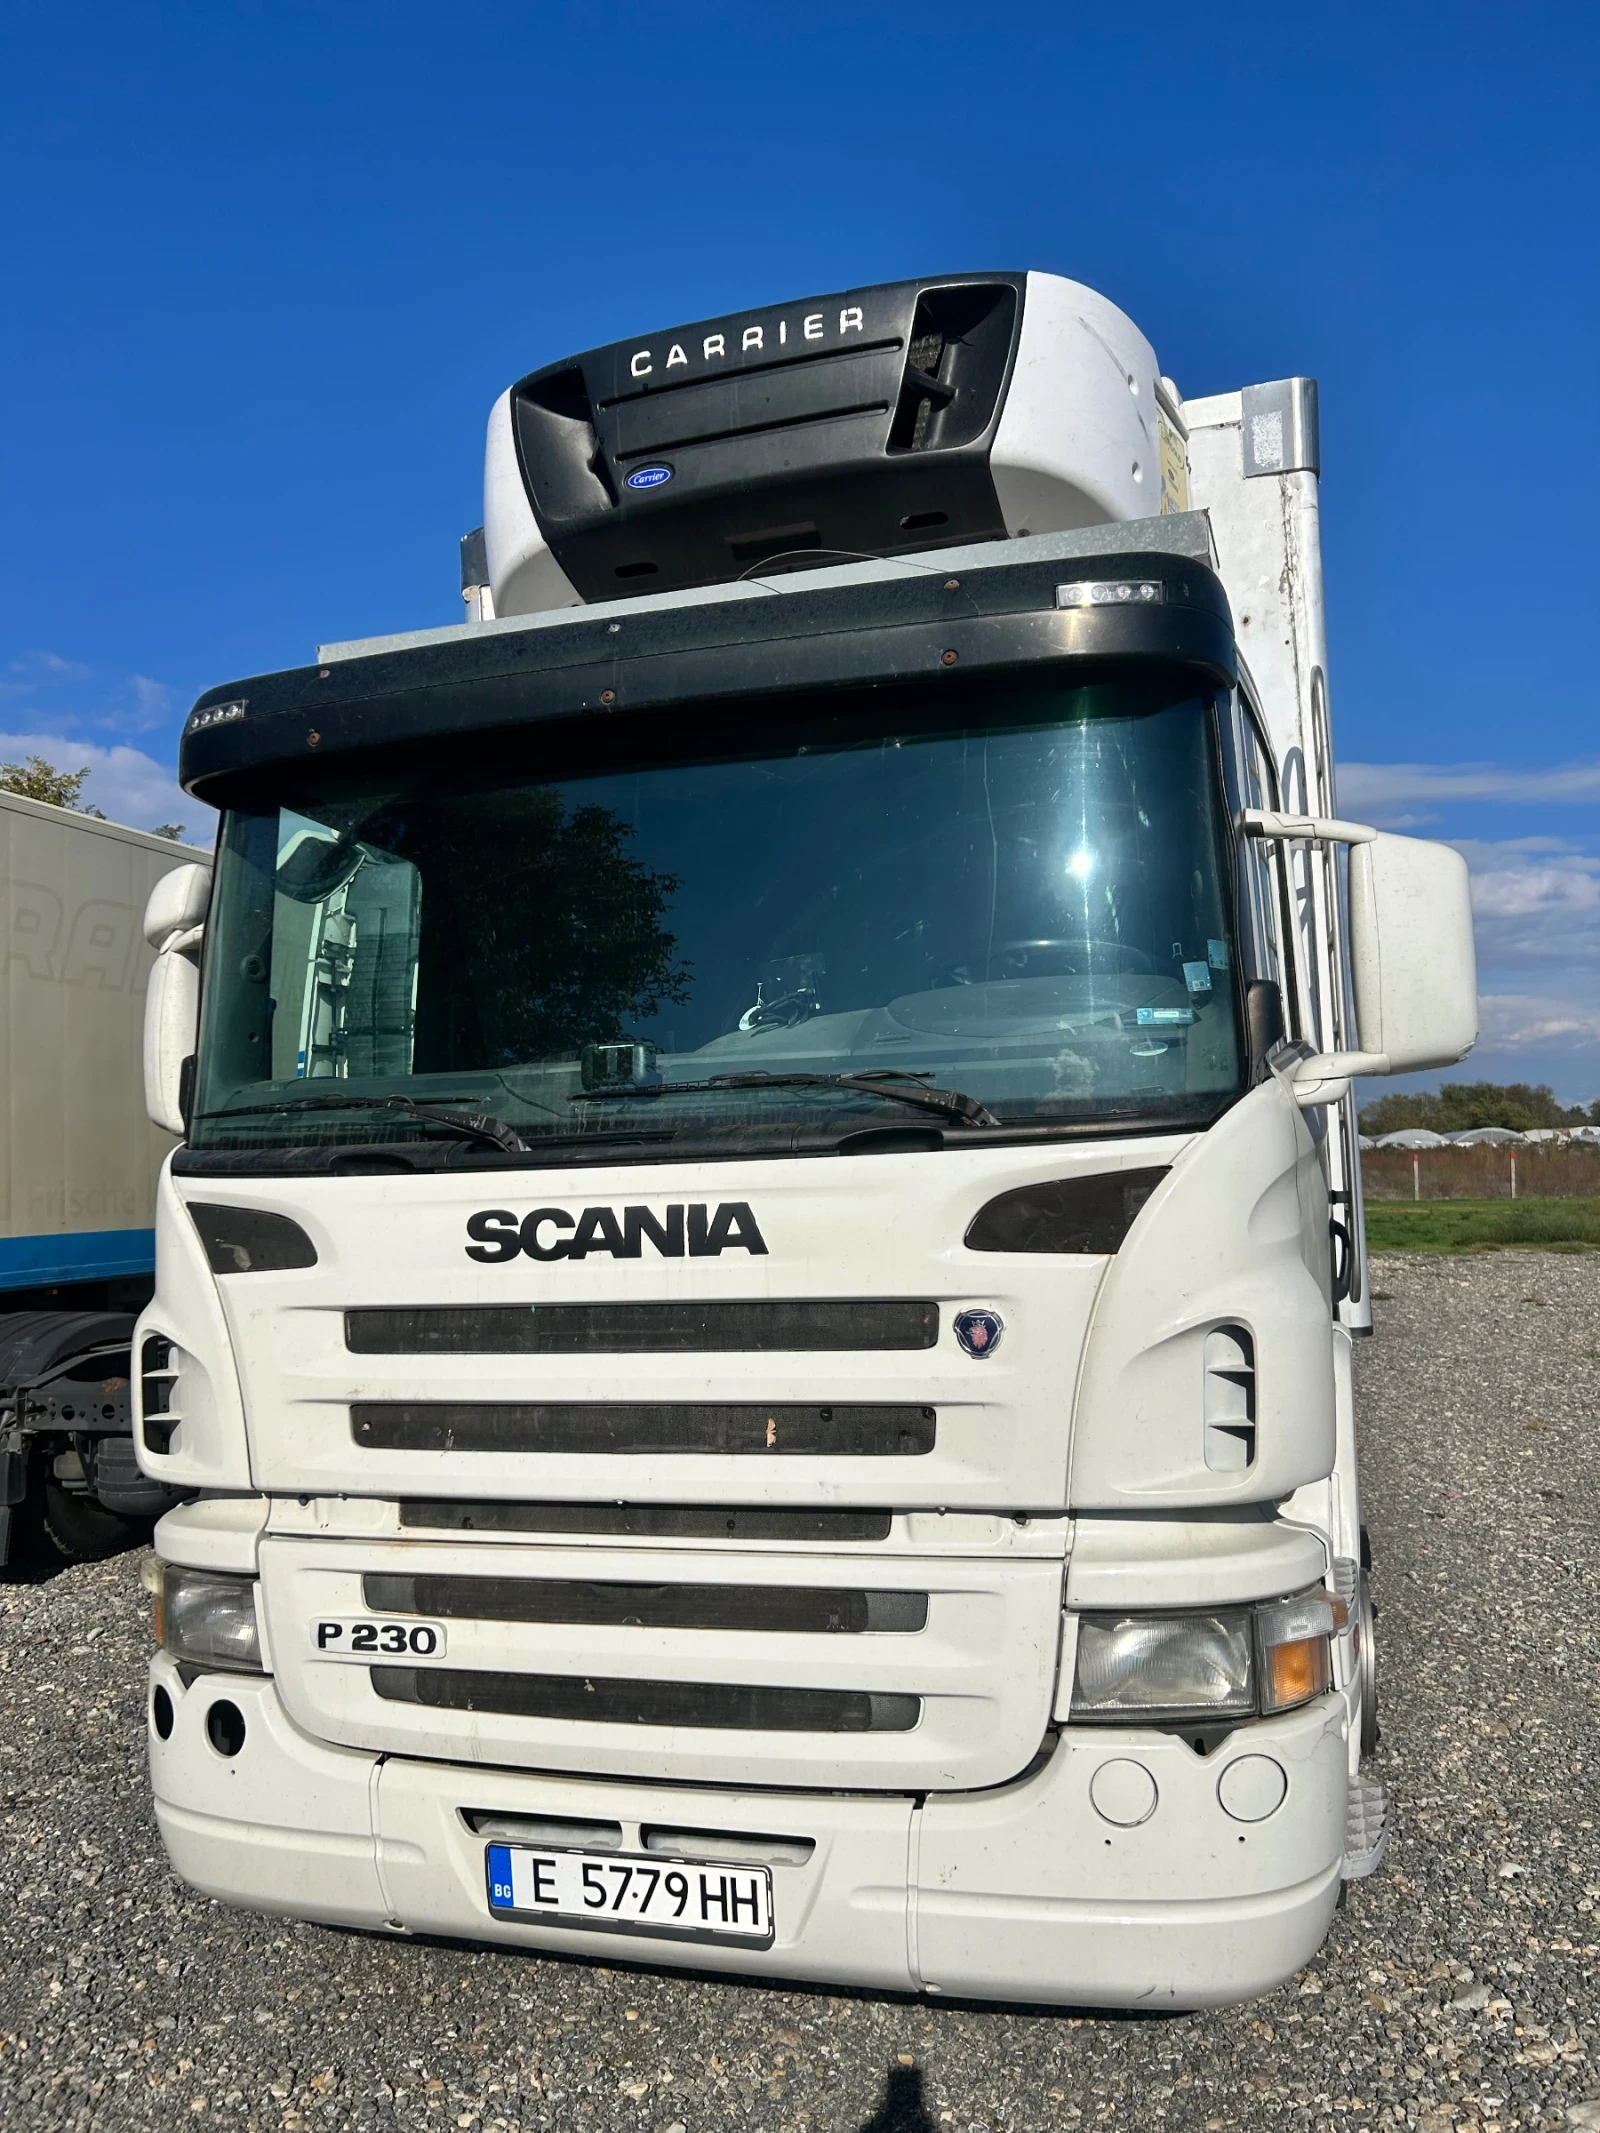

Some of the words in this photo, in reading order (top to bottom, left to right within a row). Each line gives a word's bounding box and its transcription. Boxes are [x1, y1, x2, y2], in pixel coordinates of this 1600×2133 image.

[630, 306, 864, 377] CARRIER
[633, 472, 665, 485] Carrier
[464, 1201, 770, 1264] SCANIA
[317, 1622, 343, 1649] P
[351, 1623, 437, 1655] 230
[494, 1883, 512, 1899] BG
[532, 1858, 559, 1905] E
